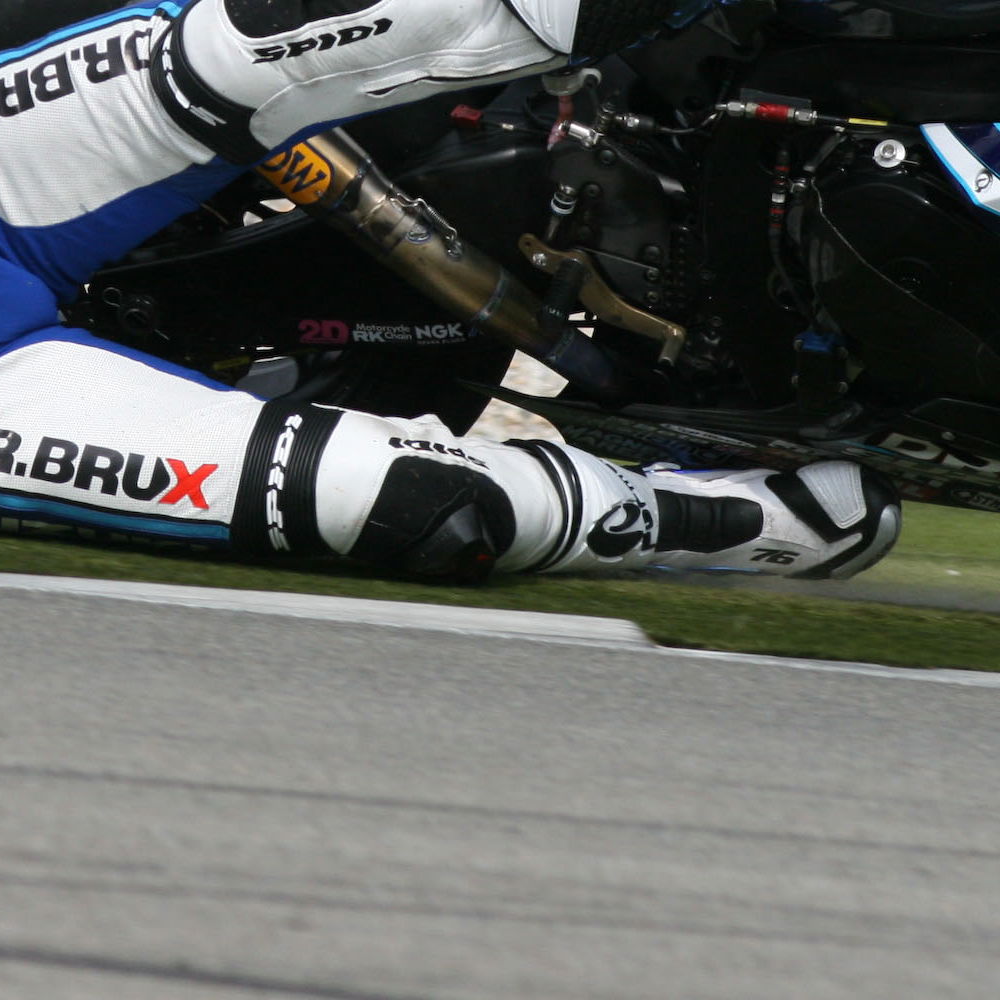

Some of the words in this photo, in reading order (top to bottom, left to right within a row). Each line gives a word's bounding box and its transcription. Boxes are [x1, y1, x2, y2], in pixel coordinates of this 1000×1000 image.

[252, 18, 394, 65] SPIDI
[298, 319, 350, 344] 2D
[352, 330, 386, 343] RK
[415, 322, 464, 340] NGK
[388, 437, 491, 470] SPIDI
[750, 548, 801, 566] 76
